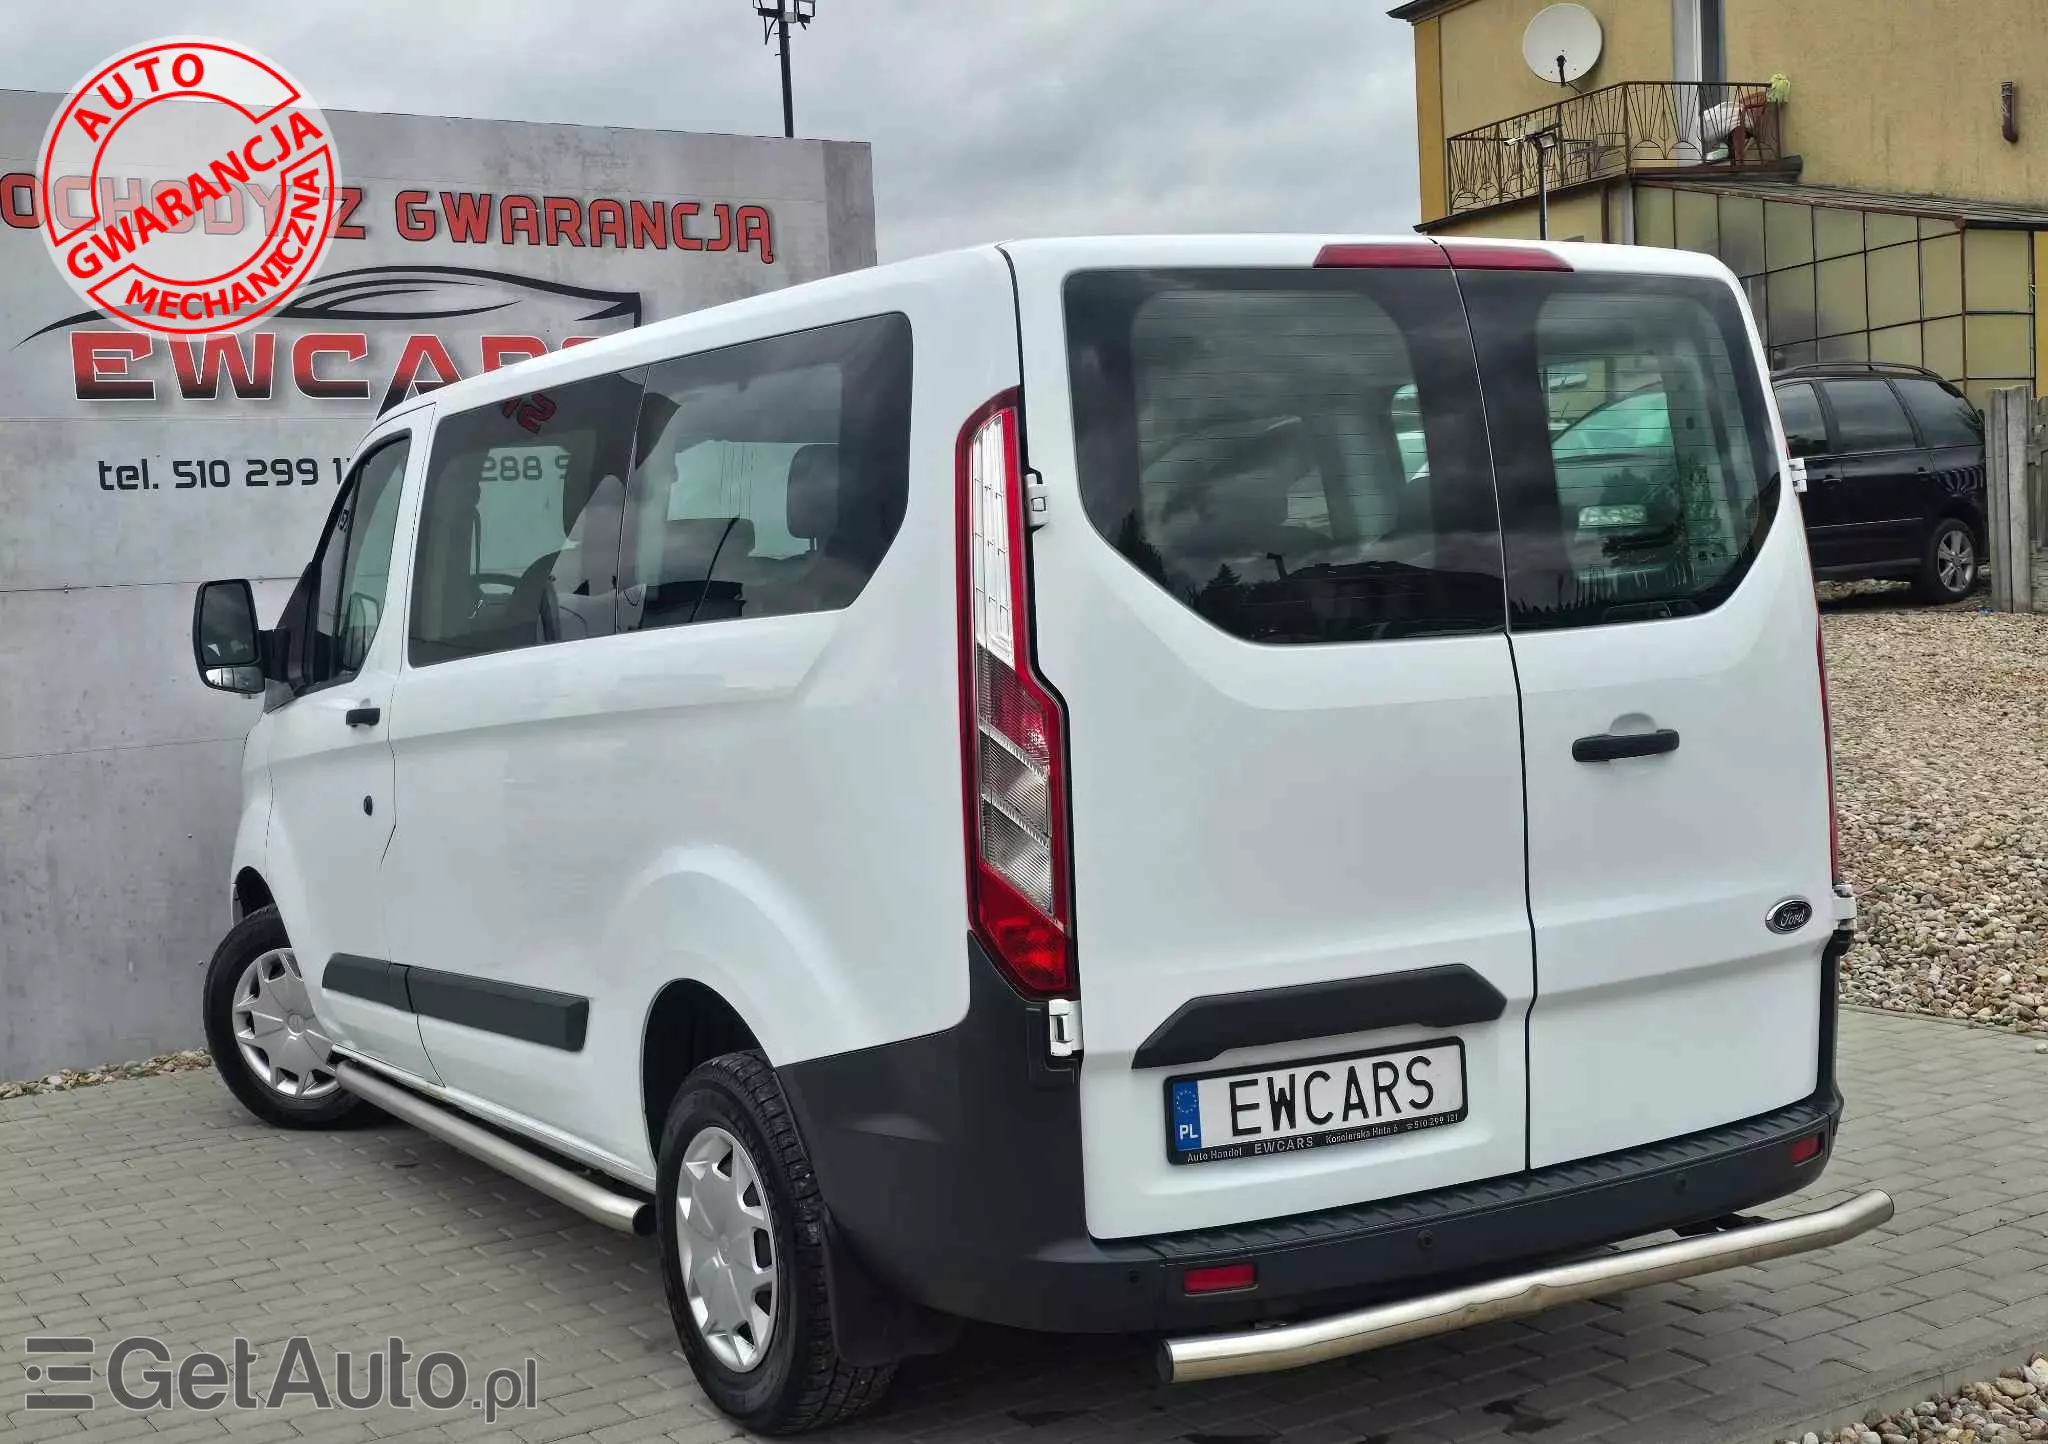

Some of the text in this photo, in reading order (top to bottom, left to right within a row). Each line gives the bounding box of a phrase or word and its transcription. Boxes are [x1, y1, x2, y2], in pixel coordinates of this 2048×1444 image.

[395, 189, 774, 265] GWARANCJĄ
[70, 330, 604, 420] EWCA
[98, 458, 159, 491] tel.
[172, 459, 230, 489] 510
[246, 457, 319, 487] 299
[1781, 909, 1806, 927] Ford
[1229, 1056, 1434, 1137] EWCARS
[1179, 1124, 1199, 1141] PL
[1187, 1152, 1208, 1163] Auto
[1254, 1136, 1314, 1155] EWCARS
